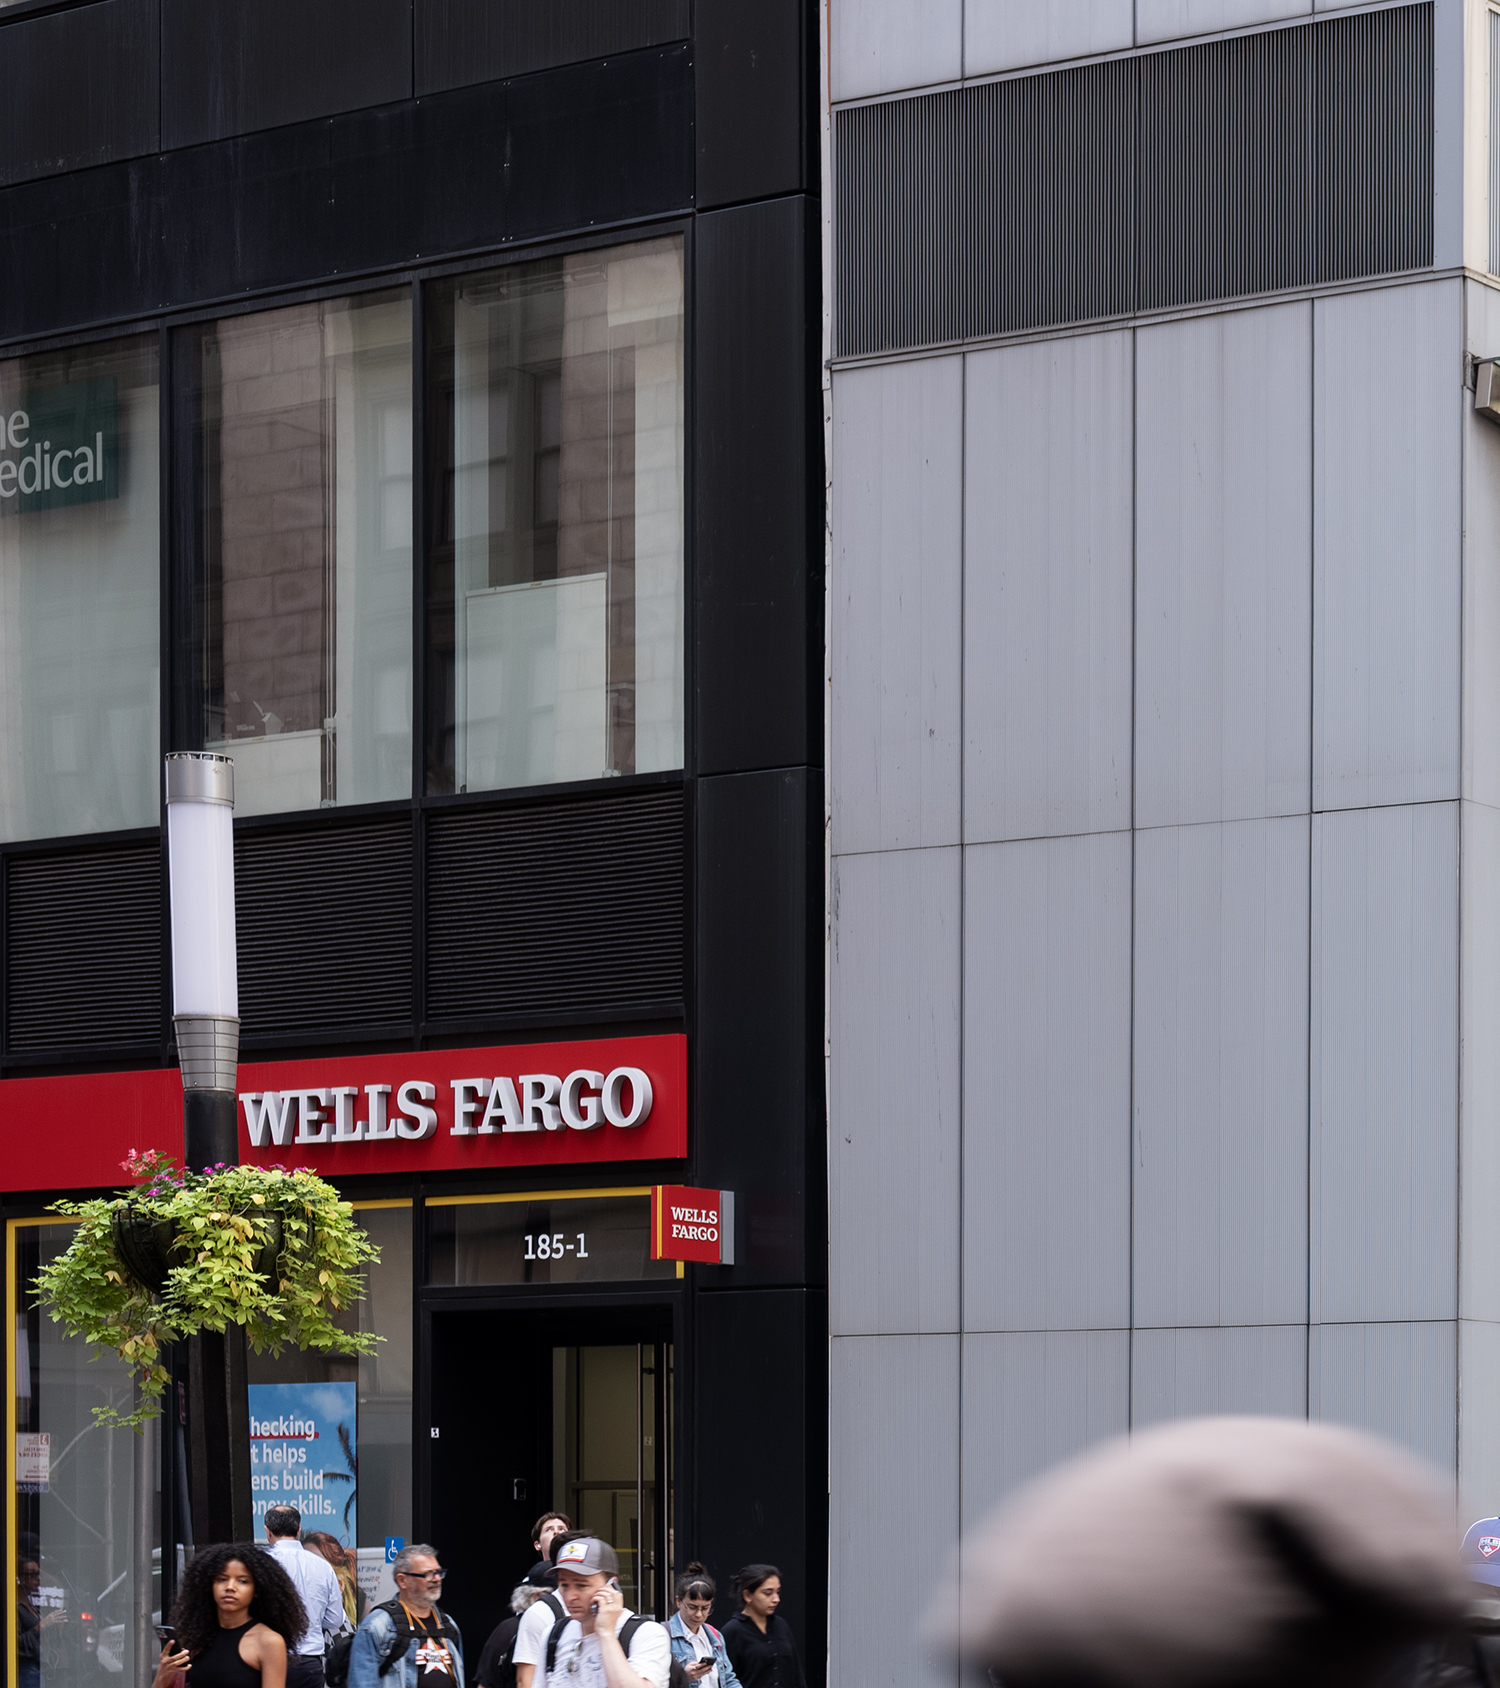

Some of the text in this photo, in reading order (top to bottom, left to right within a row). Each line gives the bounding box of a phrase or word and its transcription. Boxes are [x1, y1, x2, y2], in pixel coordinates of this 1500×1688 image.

[0, 431, 103, 498] edical
[239, 1066, 653, 1147] WELLS FARGO
[670, 1206, 718, 1226] WELLS
[524, 1233, 589, 1260] 185-1
[671, 1223, 719, 1244] FARGO
[250, 1415, 315, 1441] hecking
[263, 1442, 306, 1468] helps
[251, 1469, 324, 1491] ens build
[253, 1497, 287, 1515] oney
